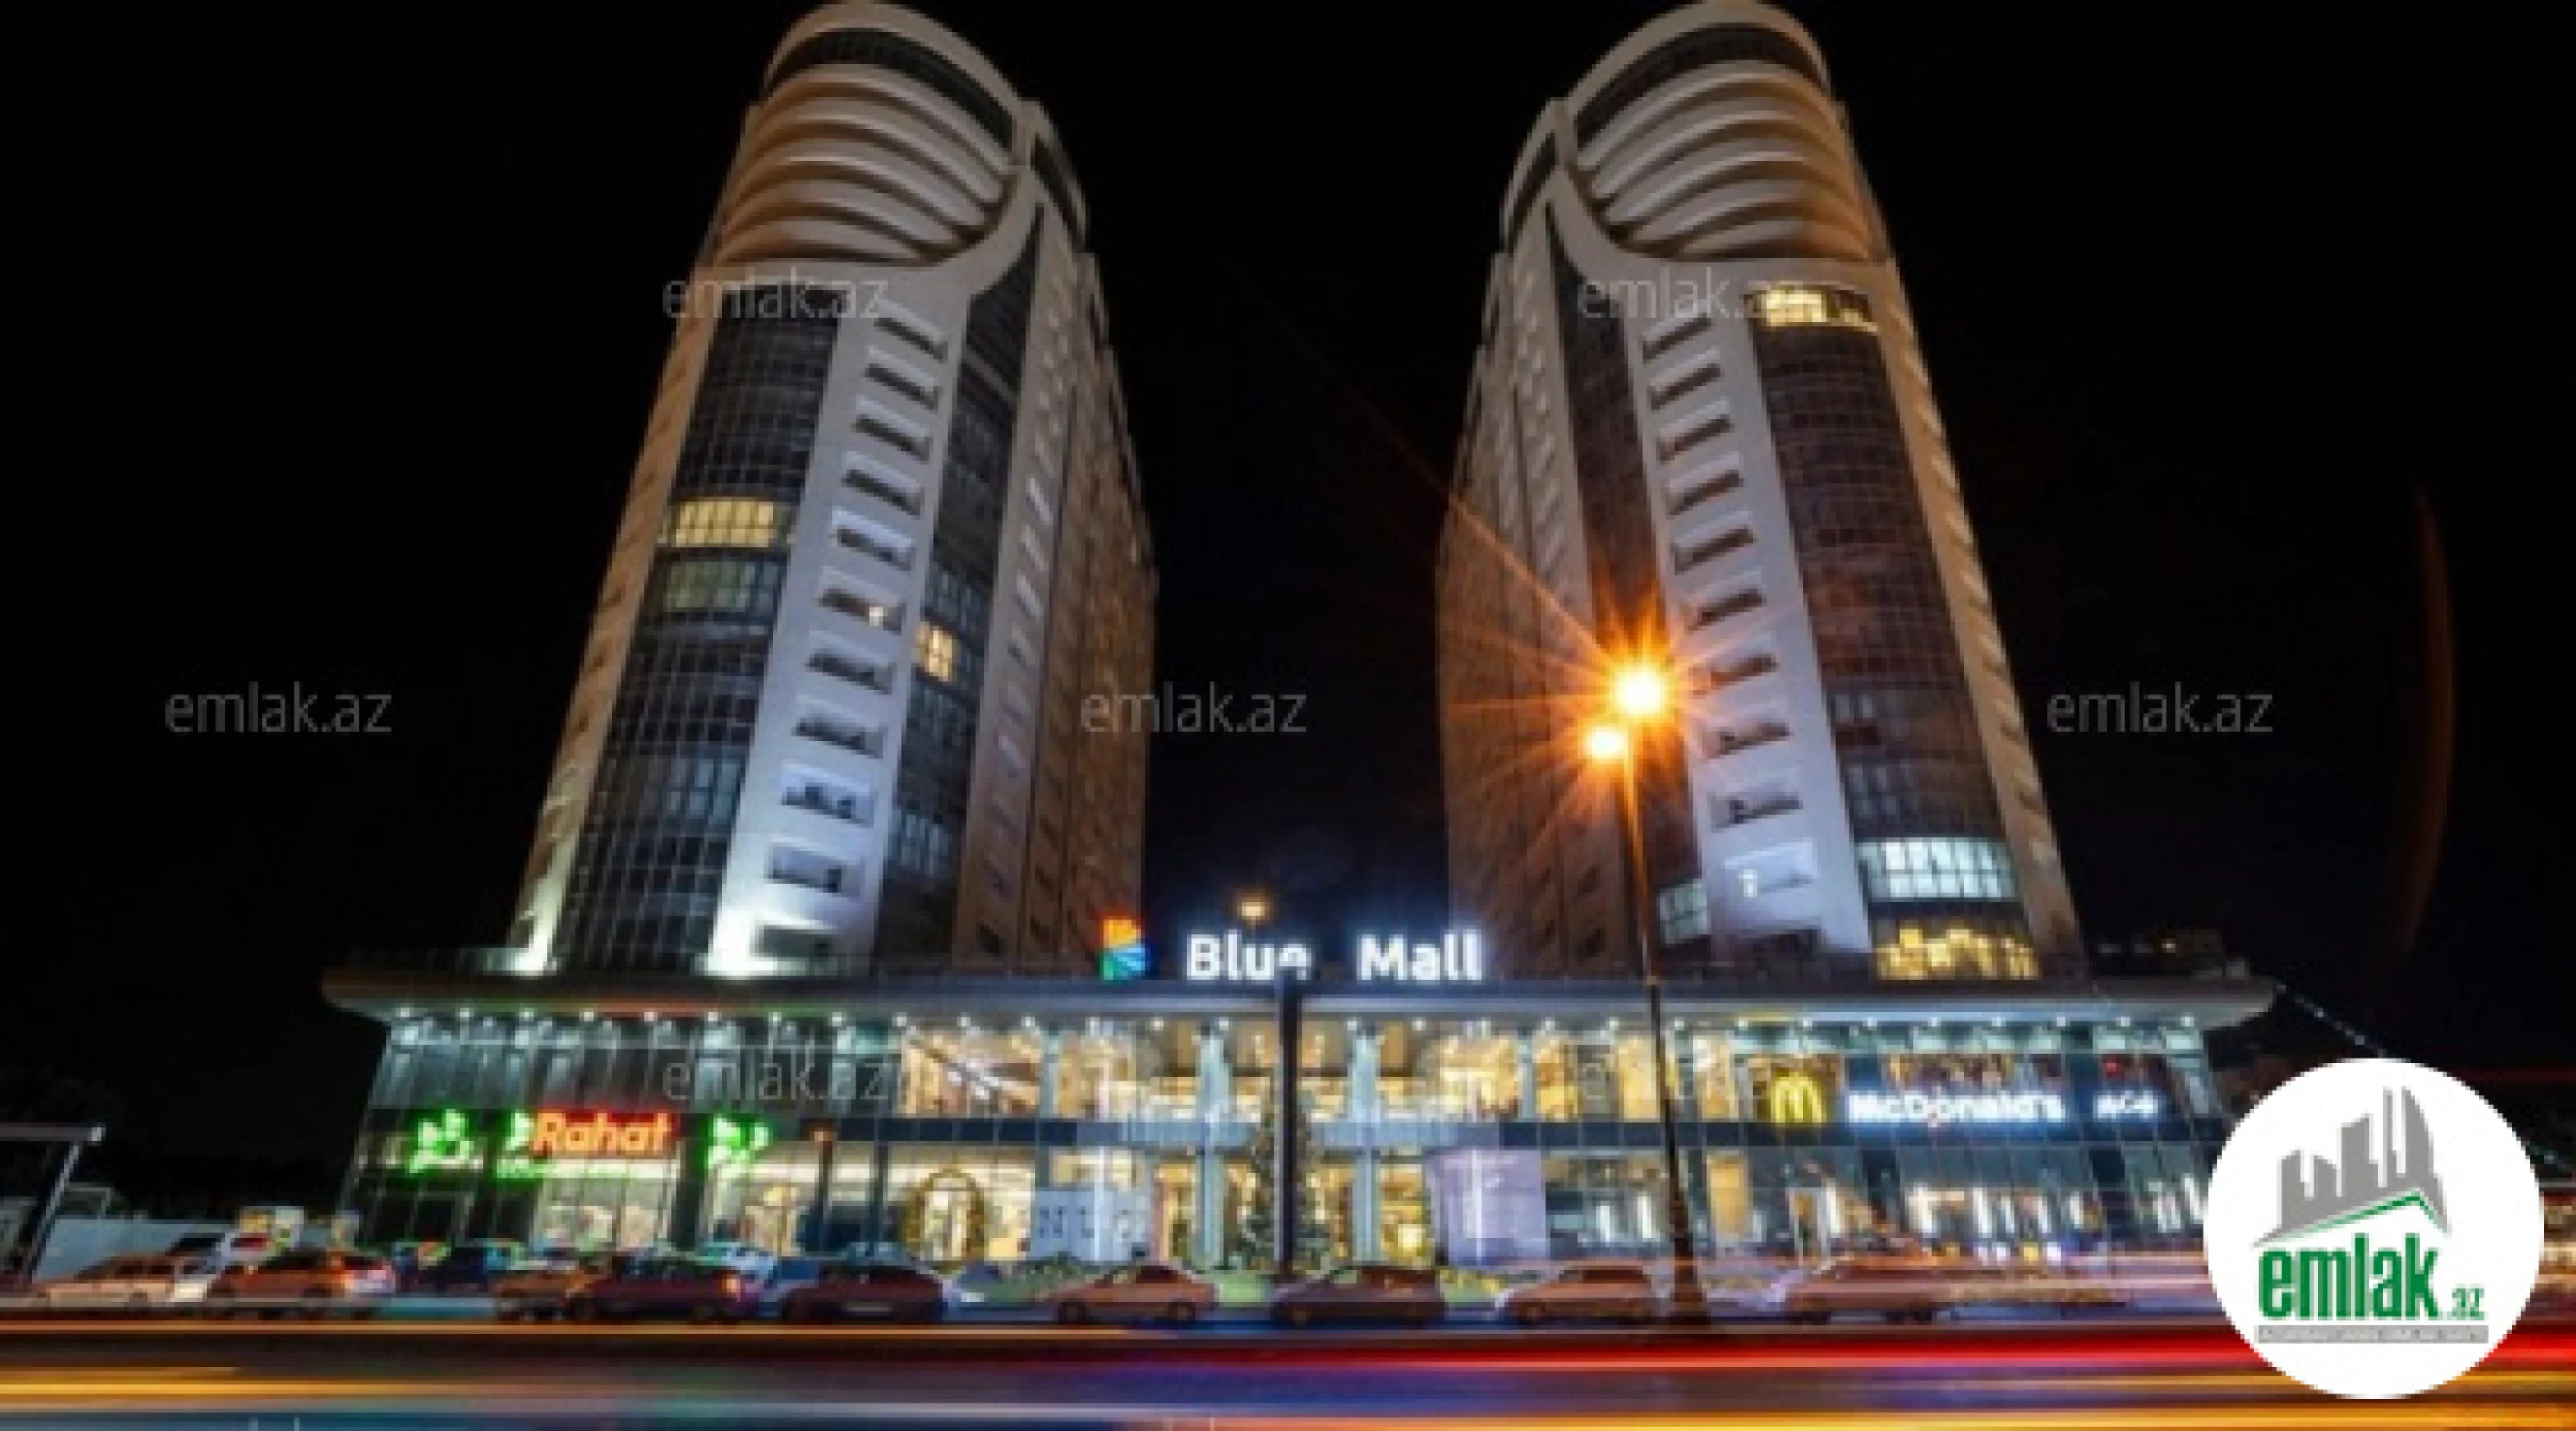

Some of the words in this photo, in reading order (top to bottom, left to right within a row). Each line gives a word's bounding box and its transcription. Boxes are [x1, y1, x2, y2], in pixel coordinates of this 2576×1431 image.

[1186, 929, 1313, 981] Blue
[1359, 929, 1483, 982] Mall
[534, 1111, 672, 1155] Rahat
